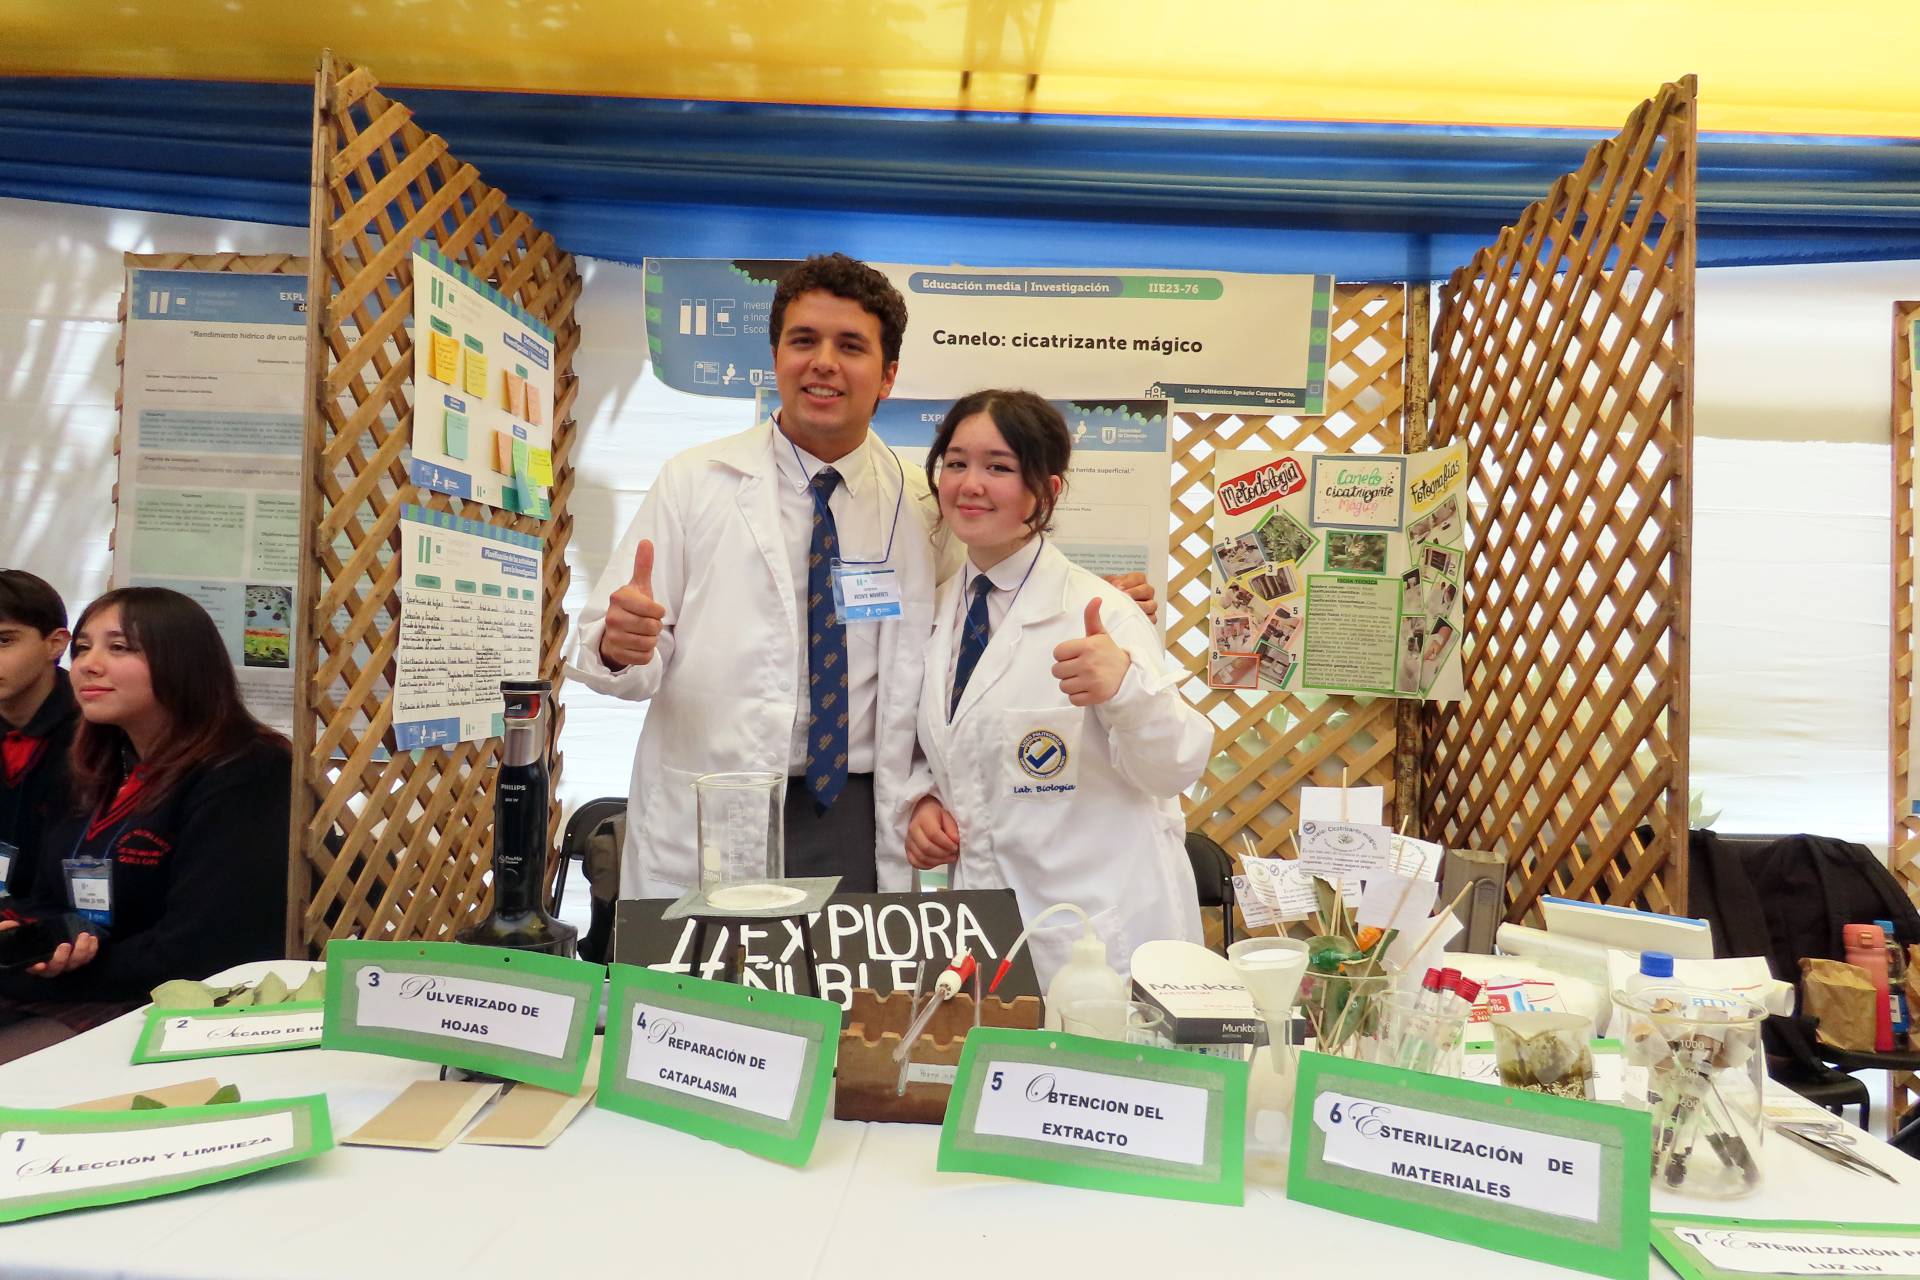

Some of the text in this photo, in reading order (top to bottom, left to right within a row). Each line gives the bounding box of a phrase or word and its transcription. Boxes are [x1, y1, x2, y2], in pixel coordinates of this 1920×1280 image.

[921, 278, 983, 292] Educación
[985, 281, 1021, 292] media
[1030, 281, 1110, 295] Investigación
[1147, 282, 1200, 295] IIE23-76
[932, 329, 1203, 356] Canelo: cicatrizante mágico
[1013, 785, 1033, 794] Lab.
[368, 972, 380, 987] 3
[399, 975, 540, 1018] PULVERIZADO DE
[176, 1019, 189, 1029] 2
[441, 1018, 489, 1035] HOJAS
[637, 1011, 647, 1030] 4
[206, 1025, 281, 1040] SECADO
[647, 1017, 767, 1070] PREPARACIÓN DE
[659, 1068, 738, 1098] CATAPLASMA
[991, 1071, 1004, 1091] 5
[1025, 1072, 1164, 1120] OBTENCION DEL
[1329, 1102, 1342, 1123] 6
[1041, 1122, 1128, 1147] EXTRACTO
[1347, 1102, 1574, 1175] ESTERILIZACIÓN DE
[15, 1138, 26, 1152] 1
[15, 1136, 273, 1178] SELECCIÓN Y LIMPIEZA
[1391, 1161, 1512, 1198] MATERIALES
[1684, 1232, 1703, 1246] 7
[1808, 1263, 1846, 1271] LUZ
